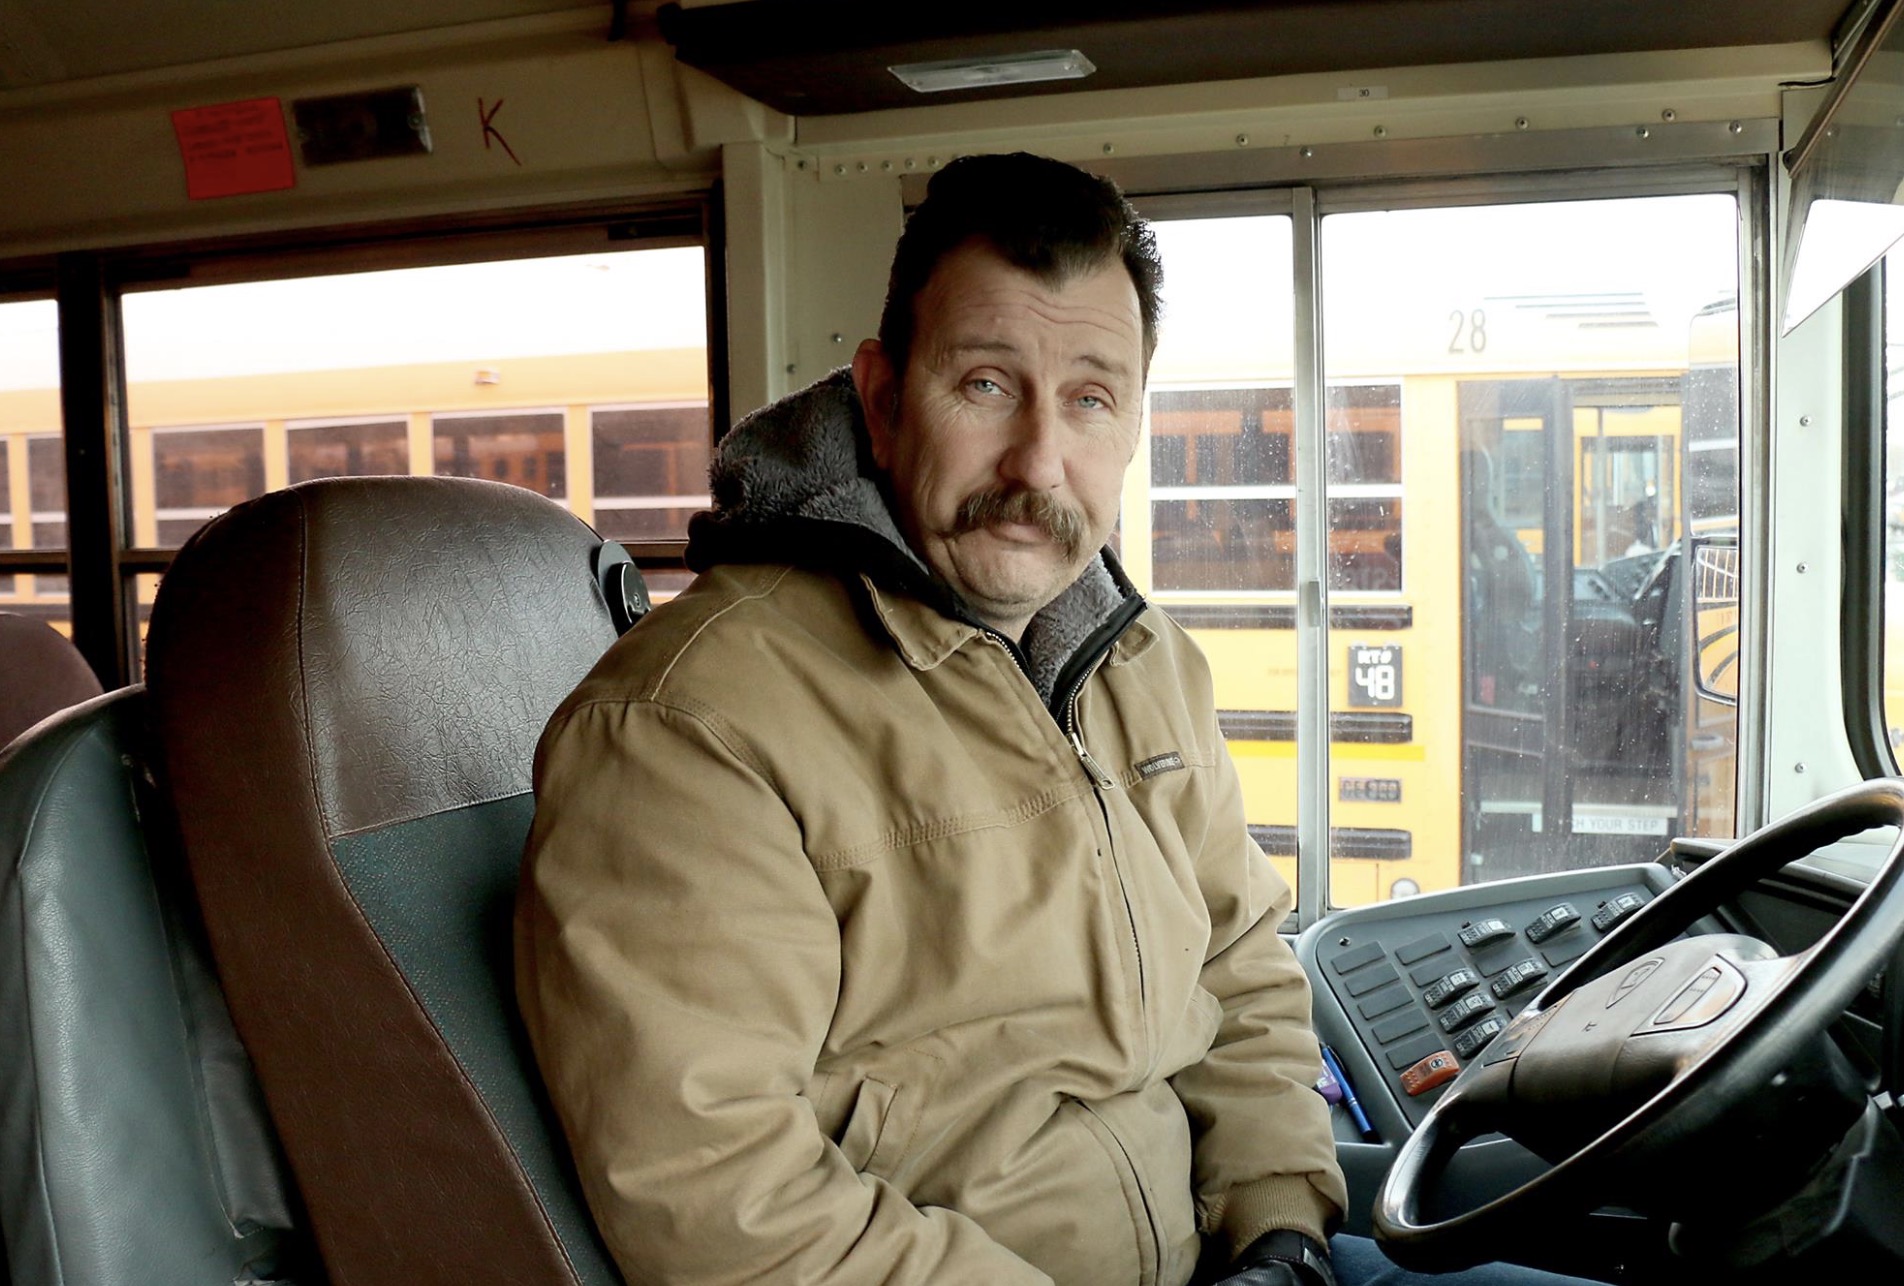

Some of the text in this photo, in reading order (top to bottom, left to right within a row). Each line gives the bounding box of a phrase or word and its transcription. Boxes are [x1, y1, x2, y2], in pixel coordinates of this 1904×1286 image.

[476, 97, 521, 166] K
[1448, 308, 1487, 354] 28
[1354, 664, 1396, 701] 48
[1590, 818, 1622, 831] YOUR
[1627, 818, 1658, 832] STEP
